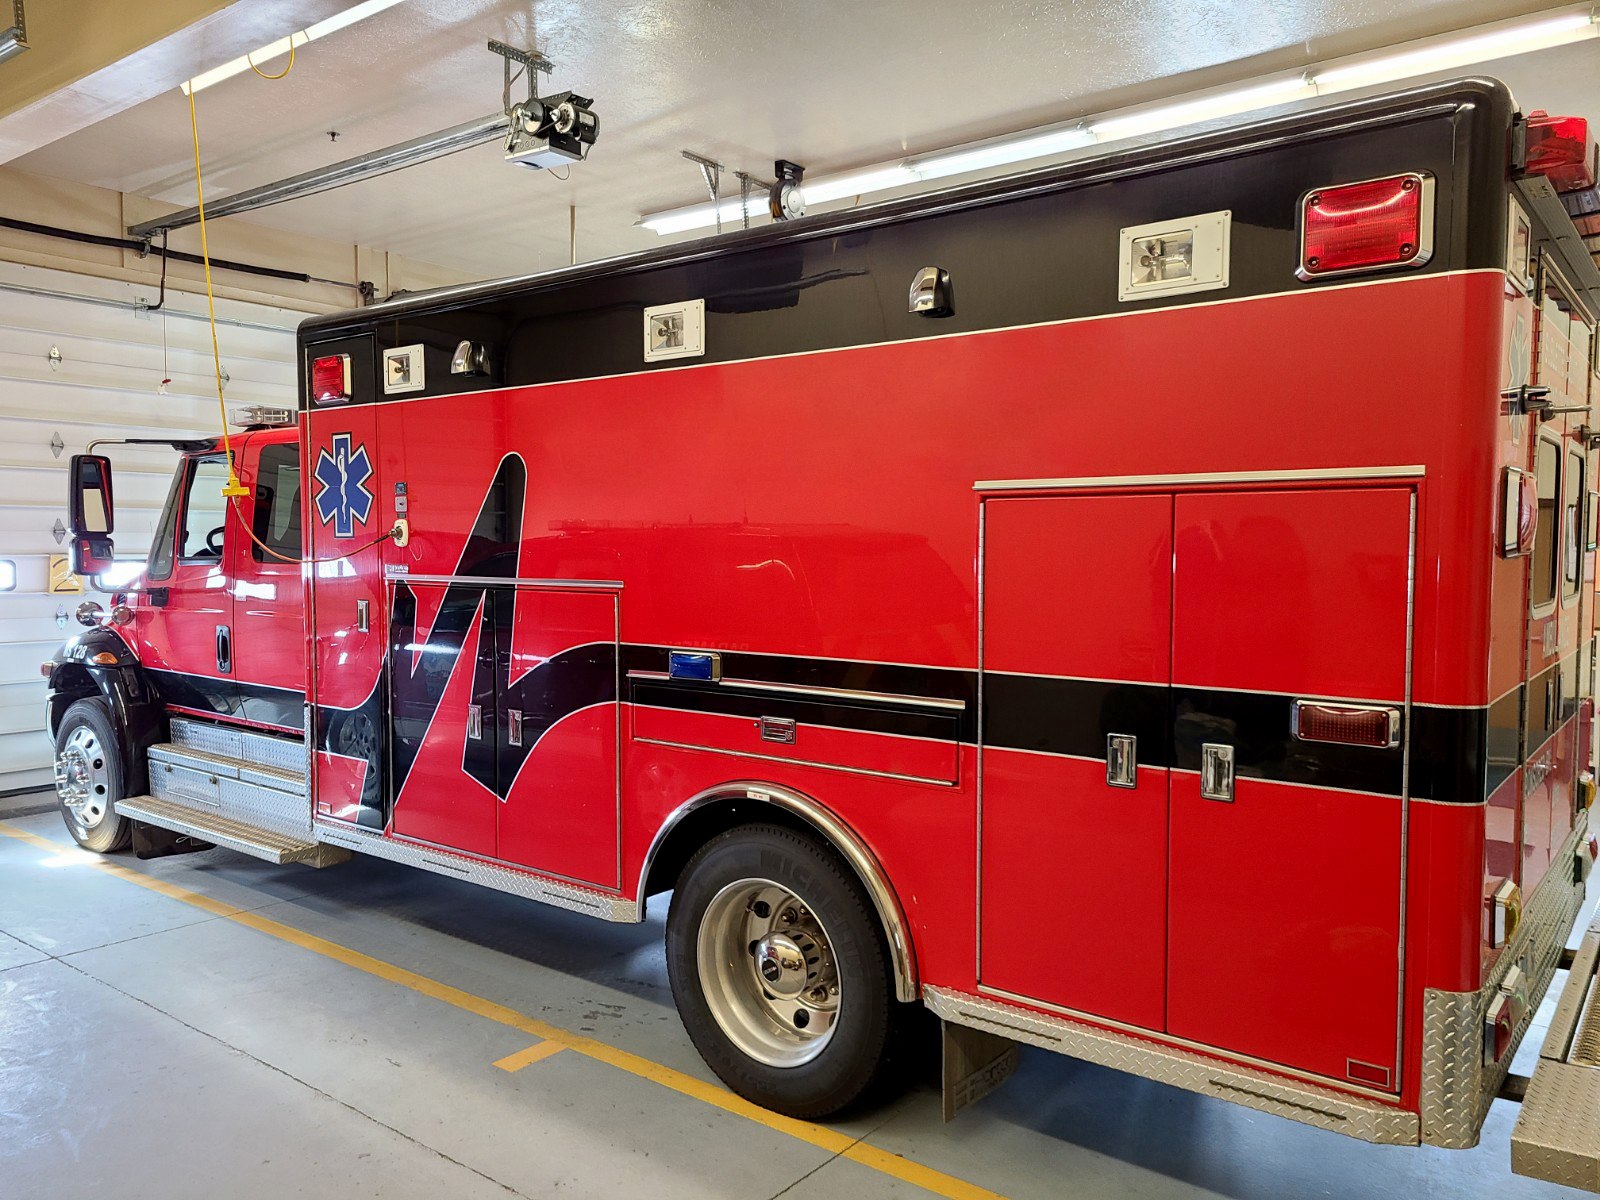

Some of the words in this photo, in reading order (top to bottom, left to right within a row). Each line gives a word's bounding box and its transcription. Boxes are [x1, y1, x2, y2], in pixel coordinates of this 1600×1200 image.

[52, 558, 79, 592] 2
[73, 645, 88, 659] 128
[759, 847, 862, 979] MICHELIN
